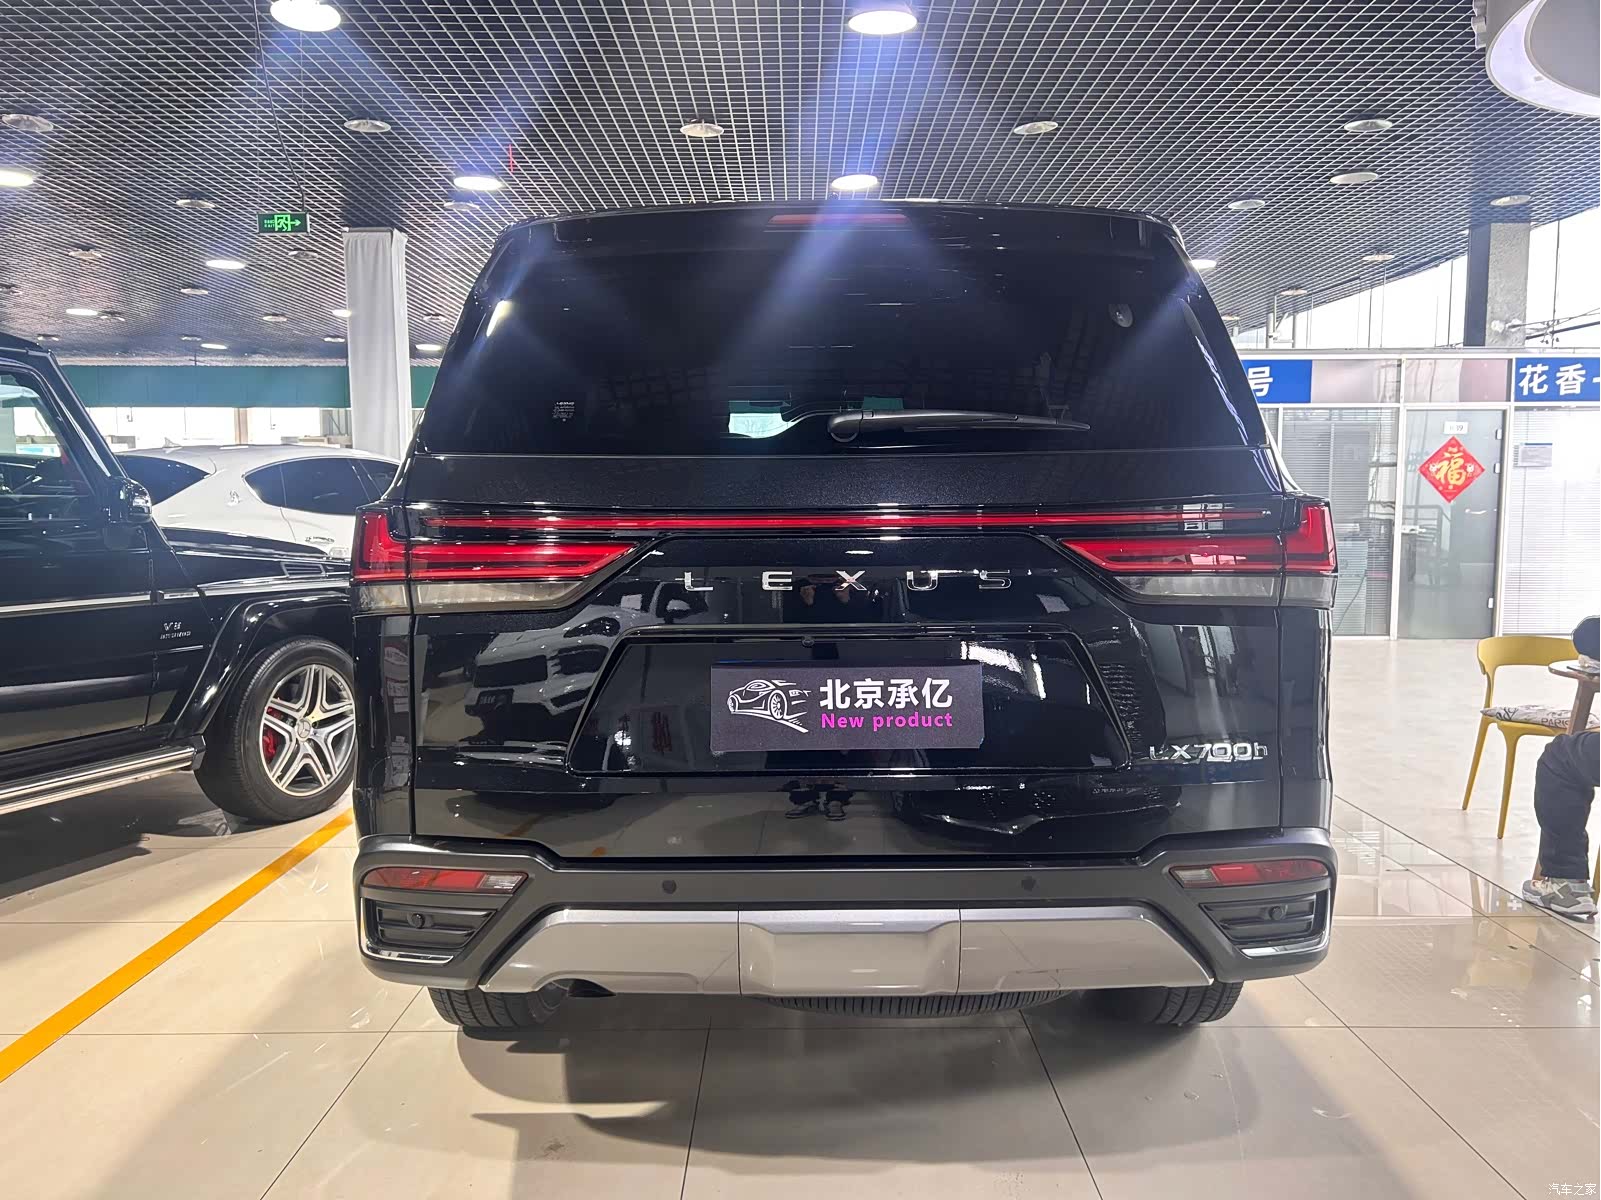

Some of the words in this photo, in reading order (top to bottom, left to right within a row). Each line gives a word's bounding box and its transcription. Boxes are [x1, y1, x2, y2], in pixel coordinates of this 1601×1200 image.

[1247, 366, 1274, 397] 号
[1518, 363, 1600, 396] 花香
[1435, 448, 1467, 485] 福
[684, 570, 1012, 591] LEXUS
[819, 677, 953, 710] 北京承亿
[821, 713, 864, 728] New
[873, 711, 953, 731] product
